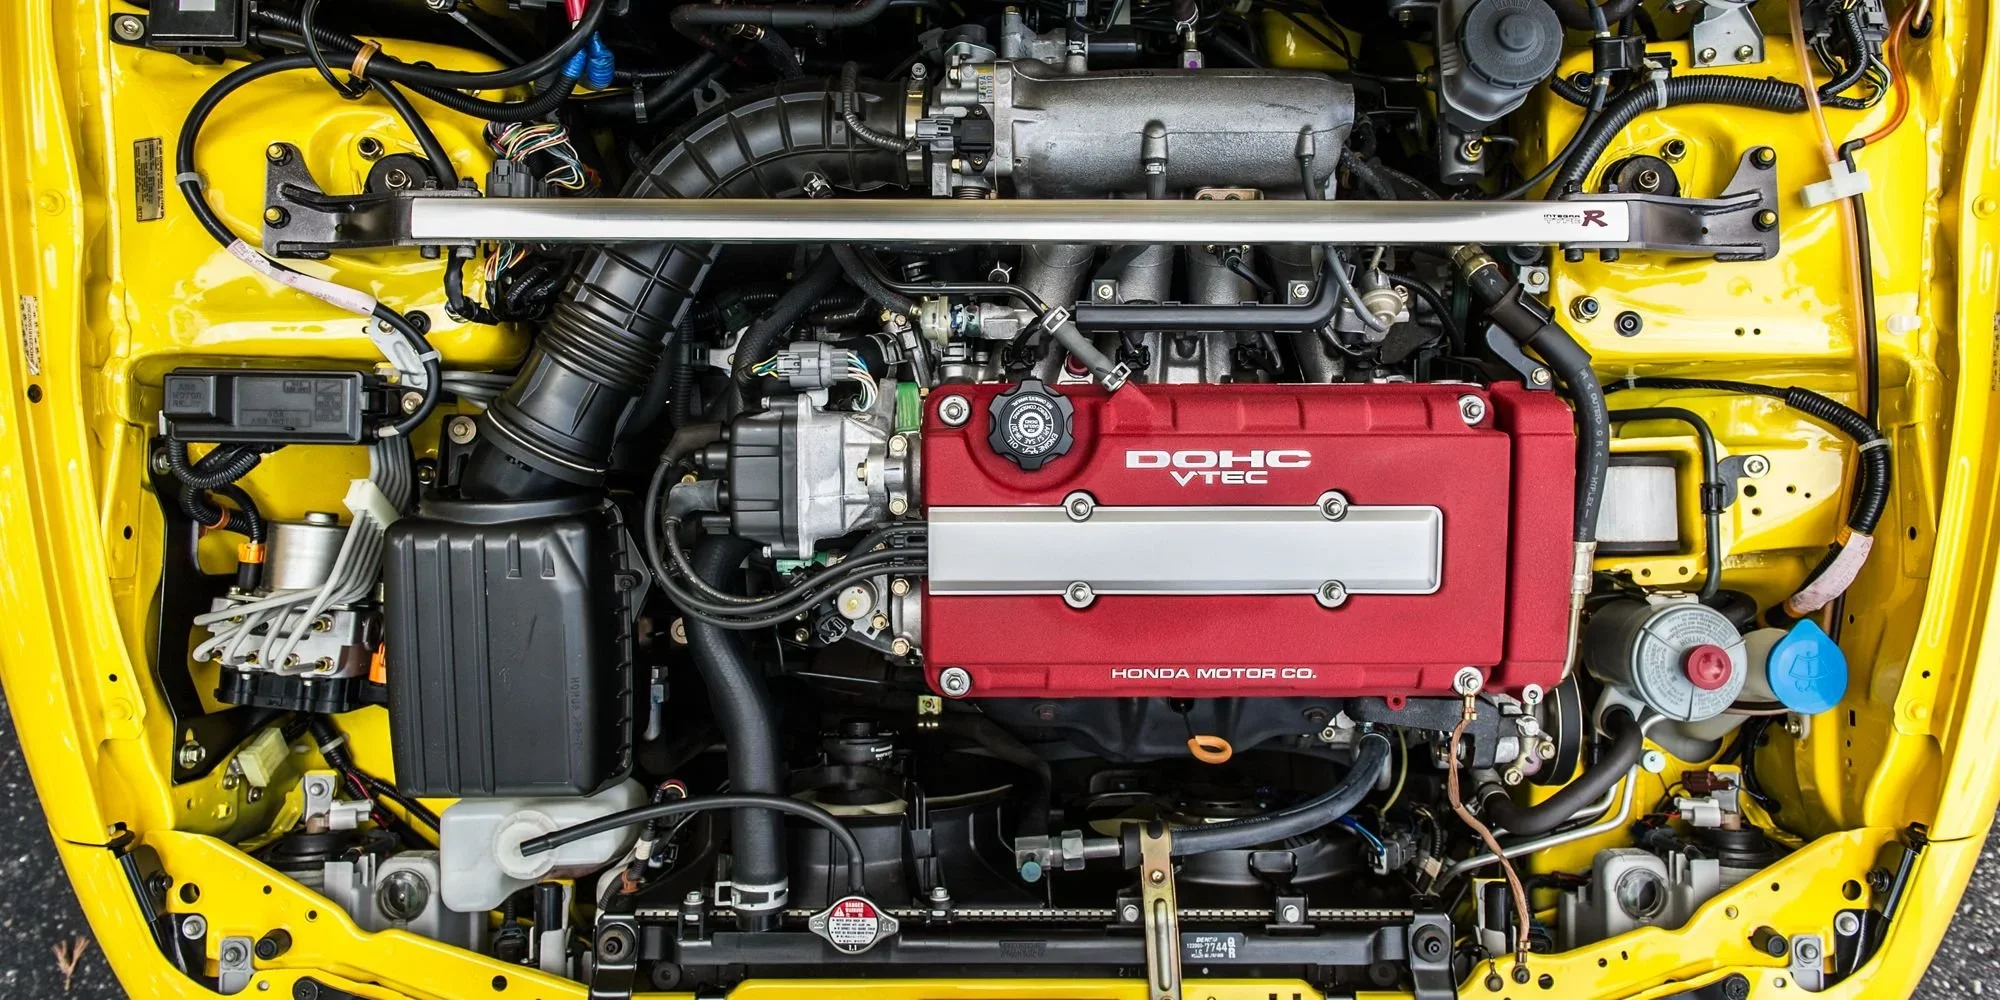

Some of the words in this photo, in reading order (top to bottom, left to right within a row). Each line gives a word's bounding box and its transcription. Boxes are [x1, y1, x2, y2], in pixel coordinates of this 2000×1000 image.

[1581, 209, 1609, 228] R
[1006, 435, 1019, 449] OIL
[1038, 432, 1059, 453] ENGINE
[1125, 449, 1312, 469] DOHC
[1169, 470, 1268, 487] VTEC
[1111, 668, 1190, 679] HONDA
[1196, 668, 1276, 679] MOTOR
[1281, 668, 1317, 679] CO.
